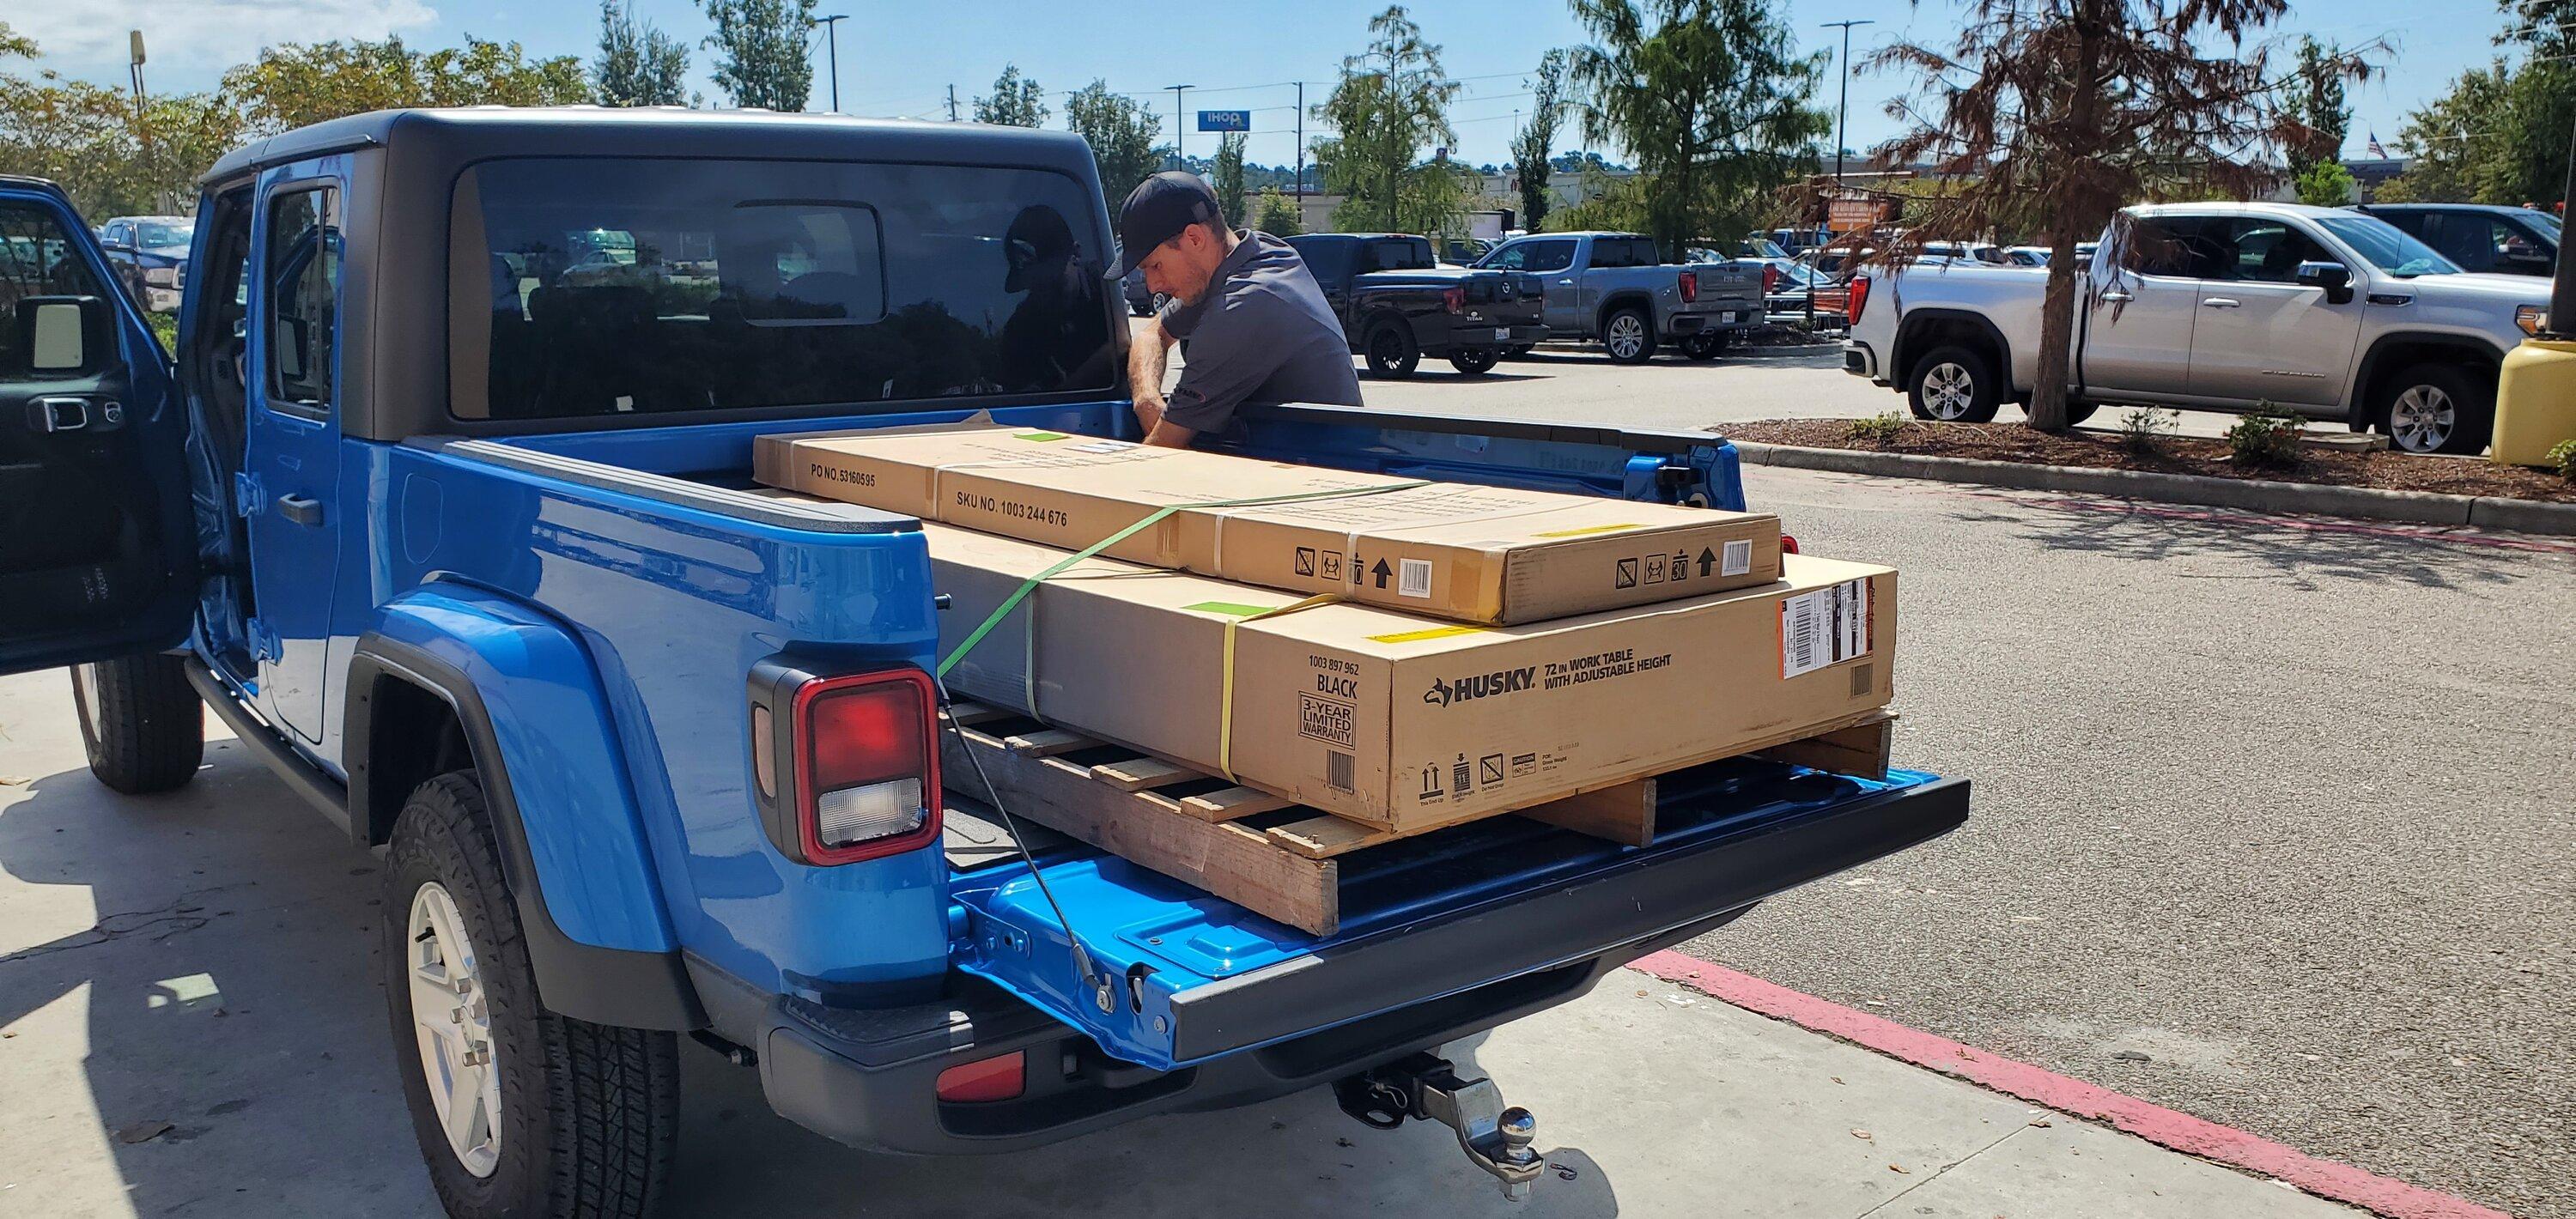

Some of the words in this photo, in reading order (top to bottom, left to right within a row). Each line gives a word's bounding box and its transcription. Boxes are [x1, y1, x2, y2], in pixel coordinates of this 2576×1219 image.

[1207, 112, 1240, 125] IHOP
[811, 463, 823, 478] PO
[957, 490, 978, 510] SKU
[980, 494, 998, 512] NO.
[1000, 500, 1025, 519] 1003
[1027, 505, 1046, 523] 244
[1048, 508, 1067, 527] 676
[1673, 561, 1686, 579] 30
[1309, 654, 1327, 669] 1003
[1328, 658, 1343, 672] 897
[1345, 662, 1359, 676] 962
[1544, 676, 1571, 690] WITH
[1572, 662, 1635, 685] ADJUSTABLE
[1636, 654, 1672, 672] HEIGHT
[1545, 663, 1558, 677] 72
[1569, 654, 1601, 672] WORK
[1602, 648, 1634, 666] TABLE
[1317, 674, 1358, 700] BLACK
[1303, 699, 1351, 721] 3-YEAR
[1303, 710, 1351, 731] LIMITED
[1303, 721, 1352, 743] WARRANTY
